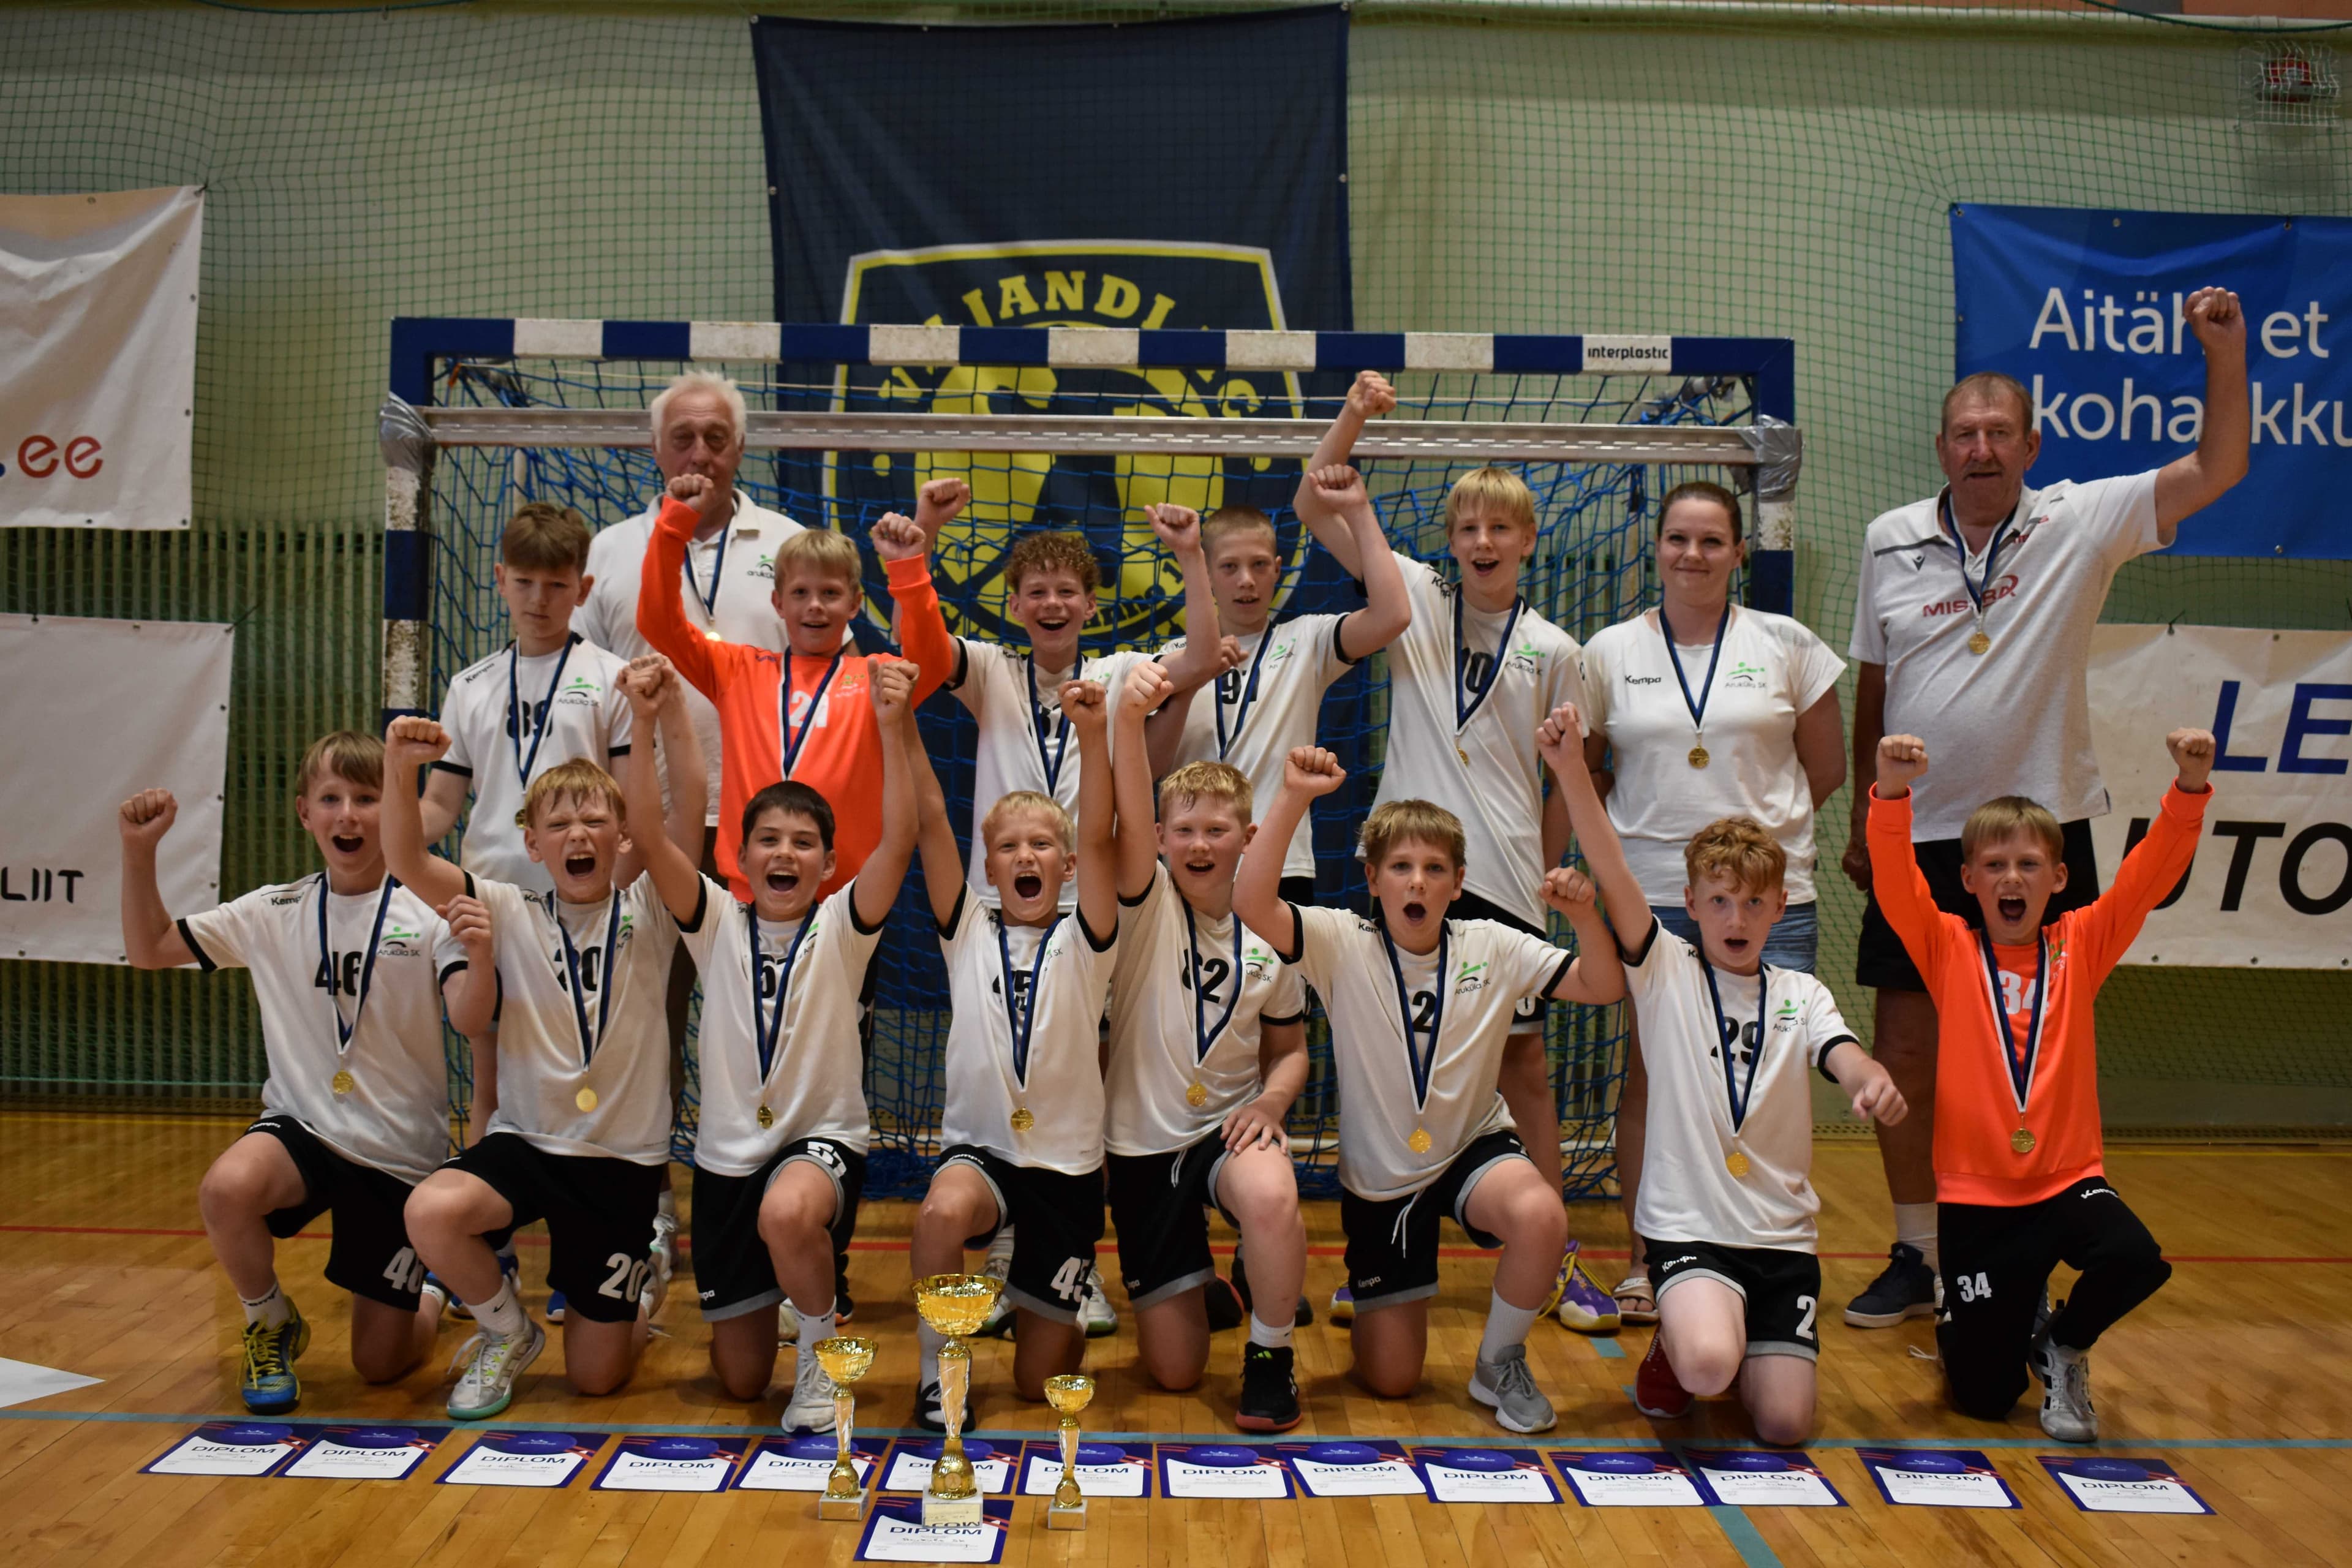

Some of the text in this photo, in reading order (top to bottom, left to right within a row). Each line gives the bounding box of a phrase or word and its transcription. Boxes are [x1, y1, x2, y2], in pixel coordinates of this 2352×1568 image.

[2260, 301, 2329, 359] et
[1588, 346, 1668, 360] interplastic
[1922, 586, 2017, 617] MISRA
[1624, 675, 1661, 686] Kempa
[1, 866, 85, 904] LIIT
[1998, 970, 2049, 1015] 34
[598, 1253, 647, 1303] 20
[1957, 1272, 1992, 1303] 34
[191, 1446, 277, 1454] DIPLOM
